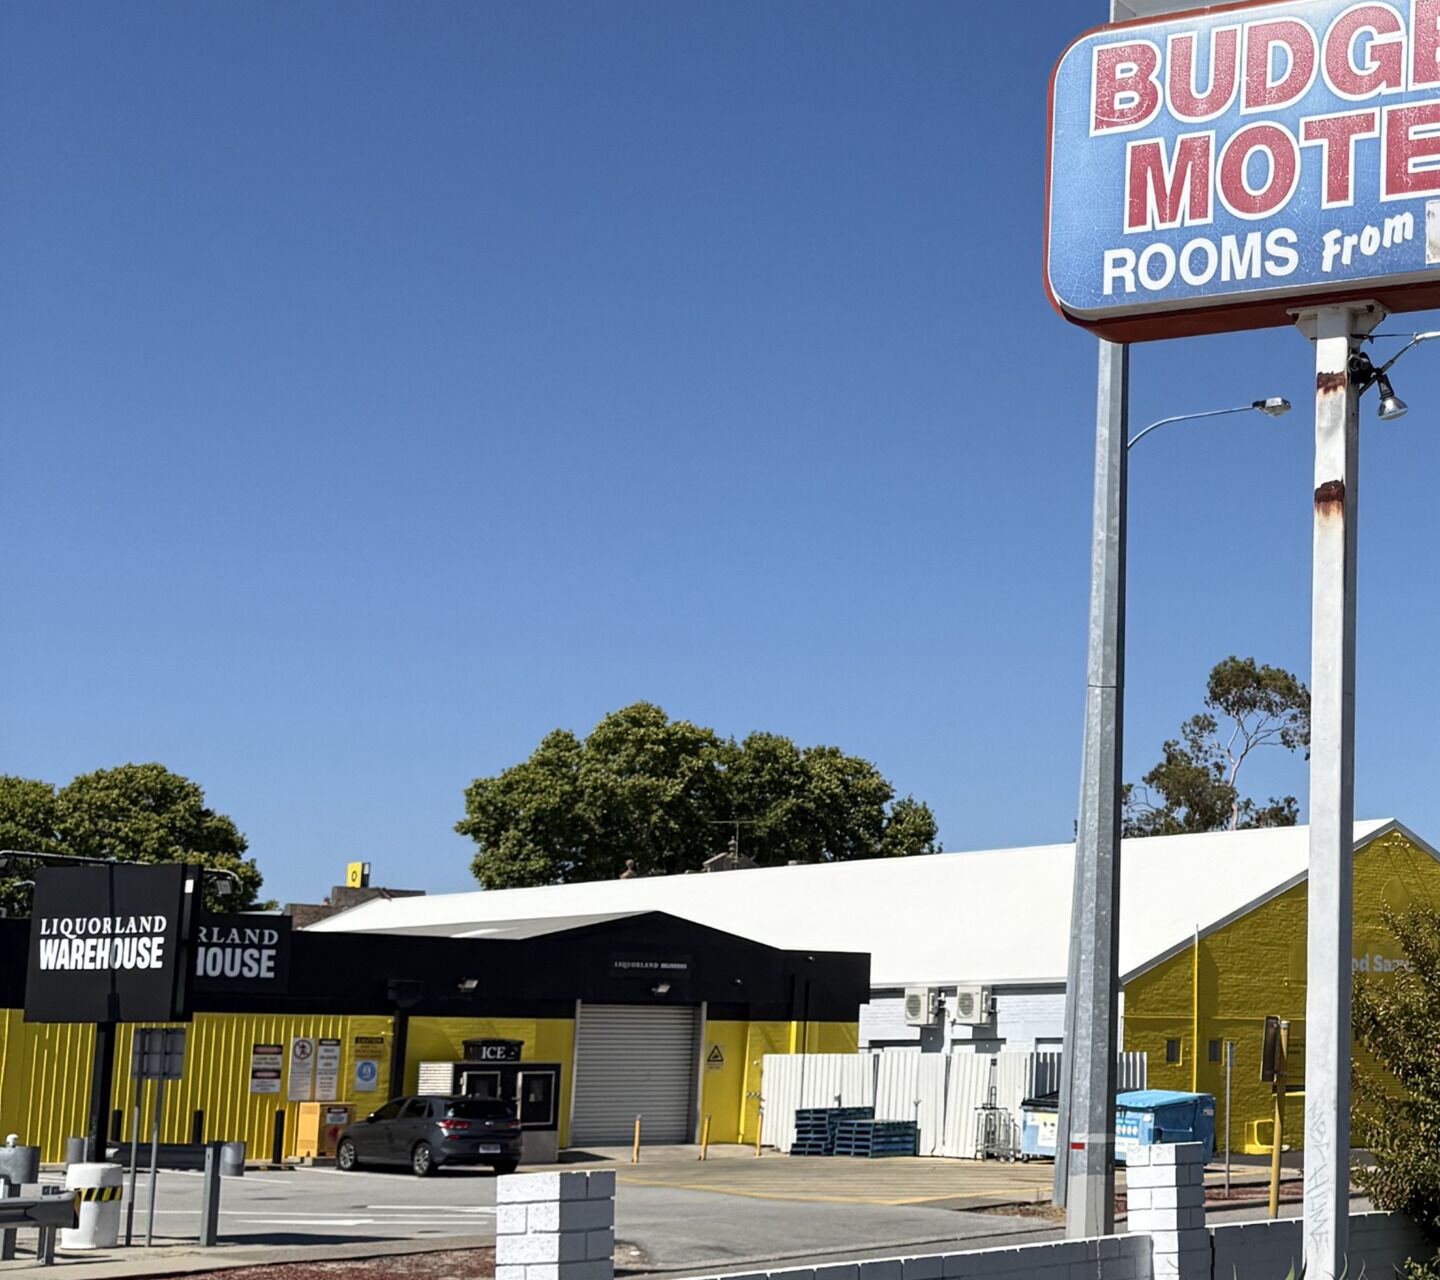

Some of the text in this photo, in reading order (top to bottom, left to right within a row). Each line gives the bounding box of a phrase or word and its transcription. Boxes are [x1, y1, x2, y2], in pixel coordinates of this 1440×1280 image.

[1102, 226, 1298, 295] ROOMS
[40, 915, 167, 939] LIQUORLAND
[39, 936, 165, 970] WAREHOUSE
[481, 1045, 507, 1060] ICE
